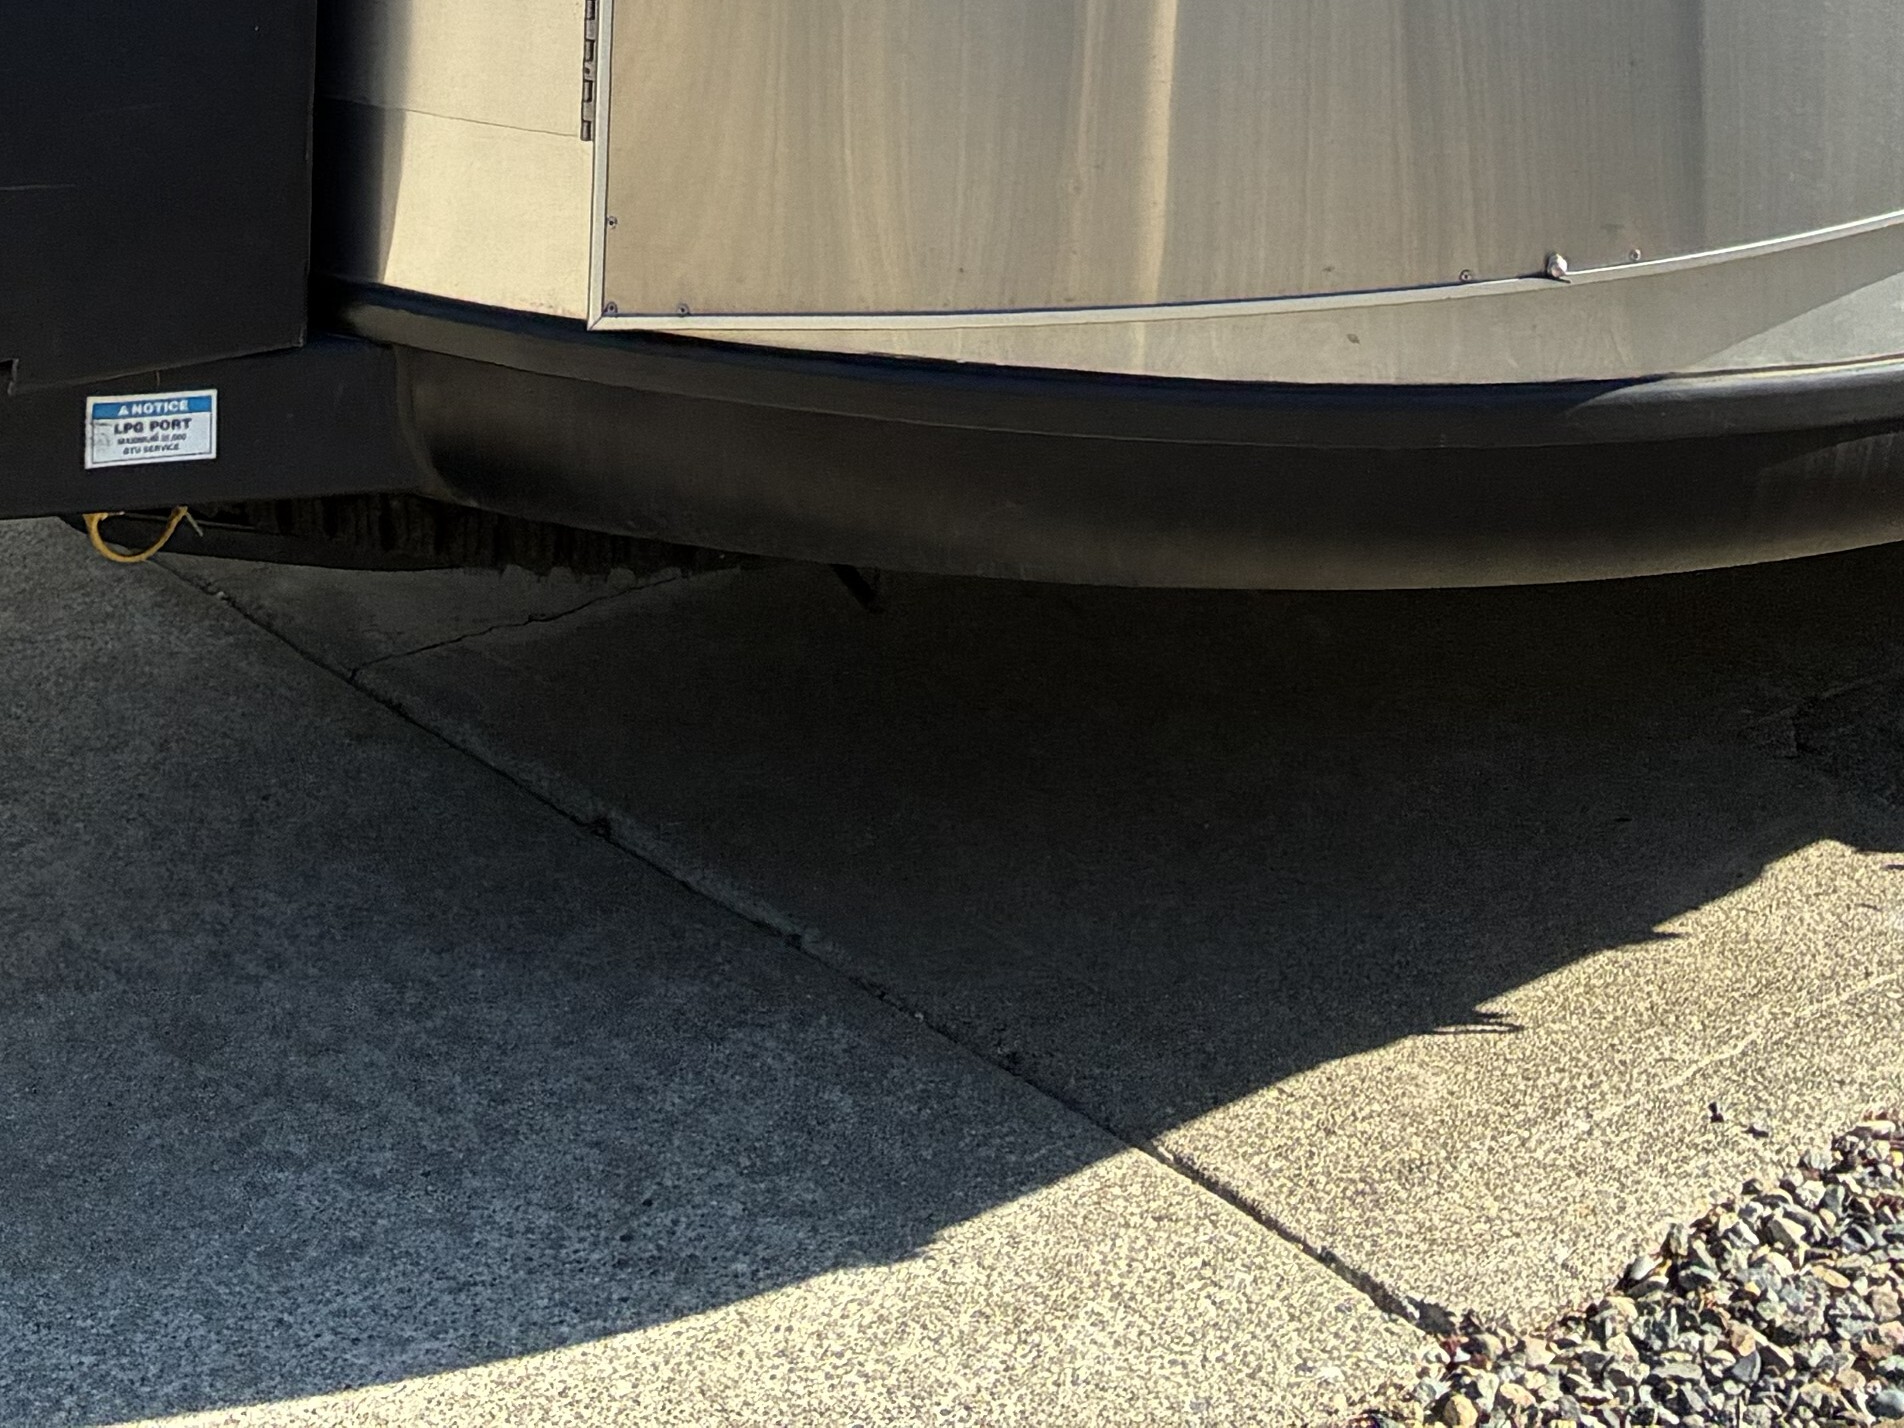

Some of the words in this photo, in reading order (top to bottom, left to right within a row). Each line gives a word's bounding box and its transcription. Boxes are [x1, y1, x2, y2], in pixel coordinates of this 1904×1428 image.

[131, 399, 189, 415] NOTICE
[114, 421, 144, 435] LPG
[149, 417, 192, 432] PORT
